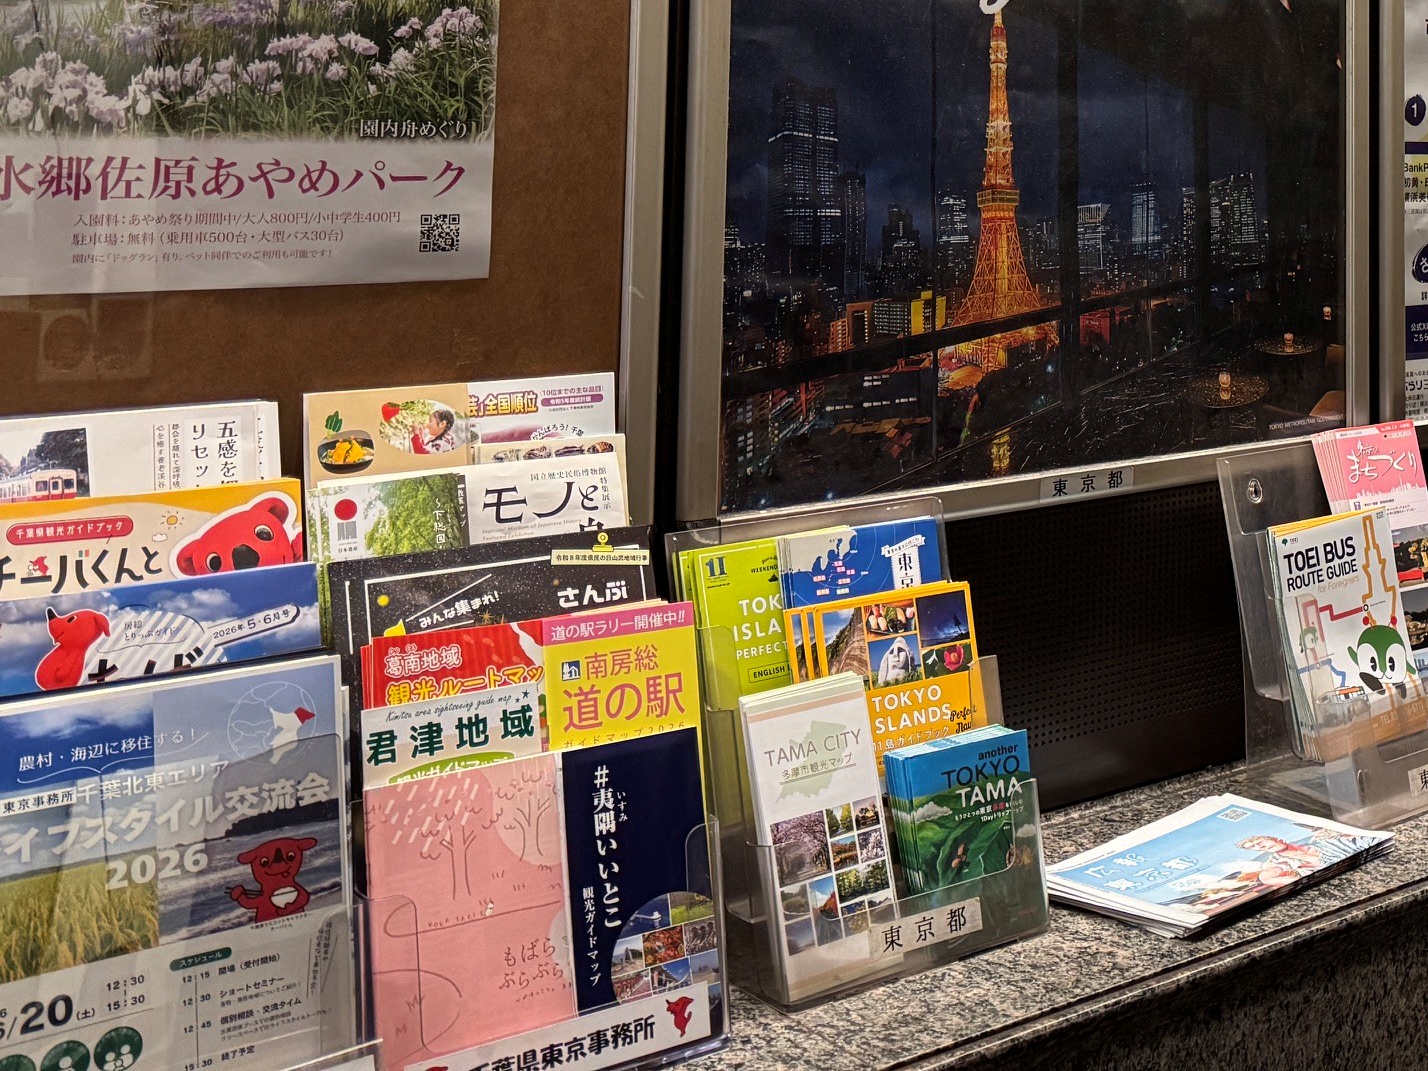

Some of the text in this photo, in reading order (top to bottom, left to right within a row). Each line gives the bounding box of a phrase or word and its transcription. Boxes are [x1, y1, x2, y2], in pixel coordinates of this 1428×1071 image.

[359, 118, 469, 140] 園内舟めぐり
[0, 155, 467, 201] 水郷佐原あやめパーク
[1413, 332, 1428, 342] こちら
[530, 467, 607, 482] 国立歴史民俗博物館
[1346, 449, 1418, 484] まちづくり
[600, 476, 612, 510] 特集展示
[1052, 469, 1124, 498] 東京都
[482, 481, 600, 525] モノと
[15, 521, 124, 540] 千葉県観光ガイドブック
[1284, 536, 1356, 575] TOEI BUS
[1287, 558, 1358, 593] ROUTE GUIDE
[1318, 574, 1360, 593] for Foreigners
[418, 590, 500, 629] みんな集まれ!
[385, 648, 463, 678] 葛南地域
[585, 644, 660, 681] 南房総
[753, 666, 785, 680] ENGLISH
[386, 694, 512, 723] Kimitsu area sightseeing guide map
[562, 671, 687, 734] 道の駅
[870, 684, 942, 714] TOKYO
[366, 703, 535, 767] 君津地域
[764, 728, 862, 768] TAMA CITY
[781, 752, 852, 780] 多摩市観光マップ
[977, 744, 1019, 761] another
[77, 759, 229, 801] 千葉北東エリア
[940, 755, 1021, 789] TOKYO
[616, 790, 628, 822] いすみ
[955, 776, 1023, 808] TAMA
[104, 844, 209, 891] 2026
[582, 886, 602, 987] 観光ガイドマップ
[882, 906, 967, 954] 東京都
[179, 951, 223, 968] スケジュール
[504, 936, 556, 967] もばら
[219, 976, 285, 999] ショートセミナー
[499, 962, 564, 990] ぶらぶら
